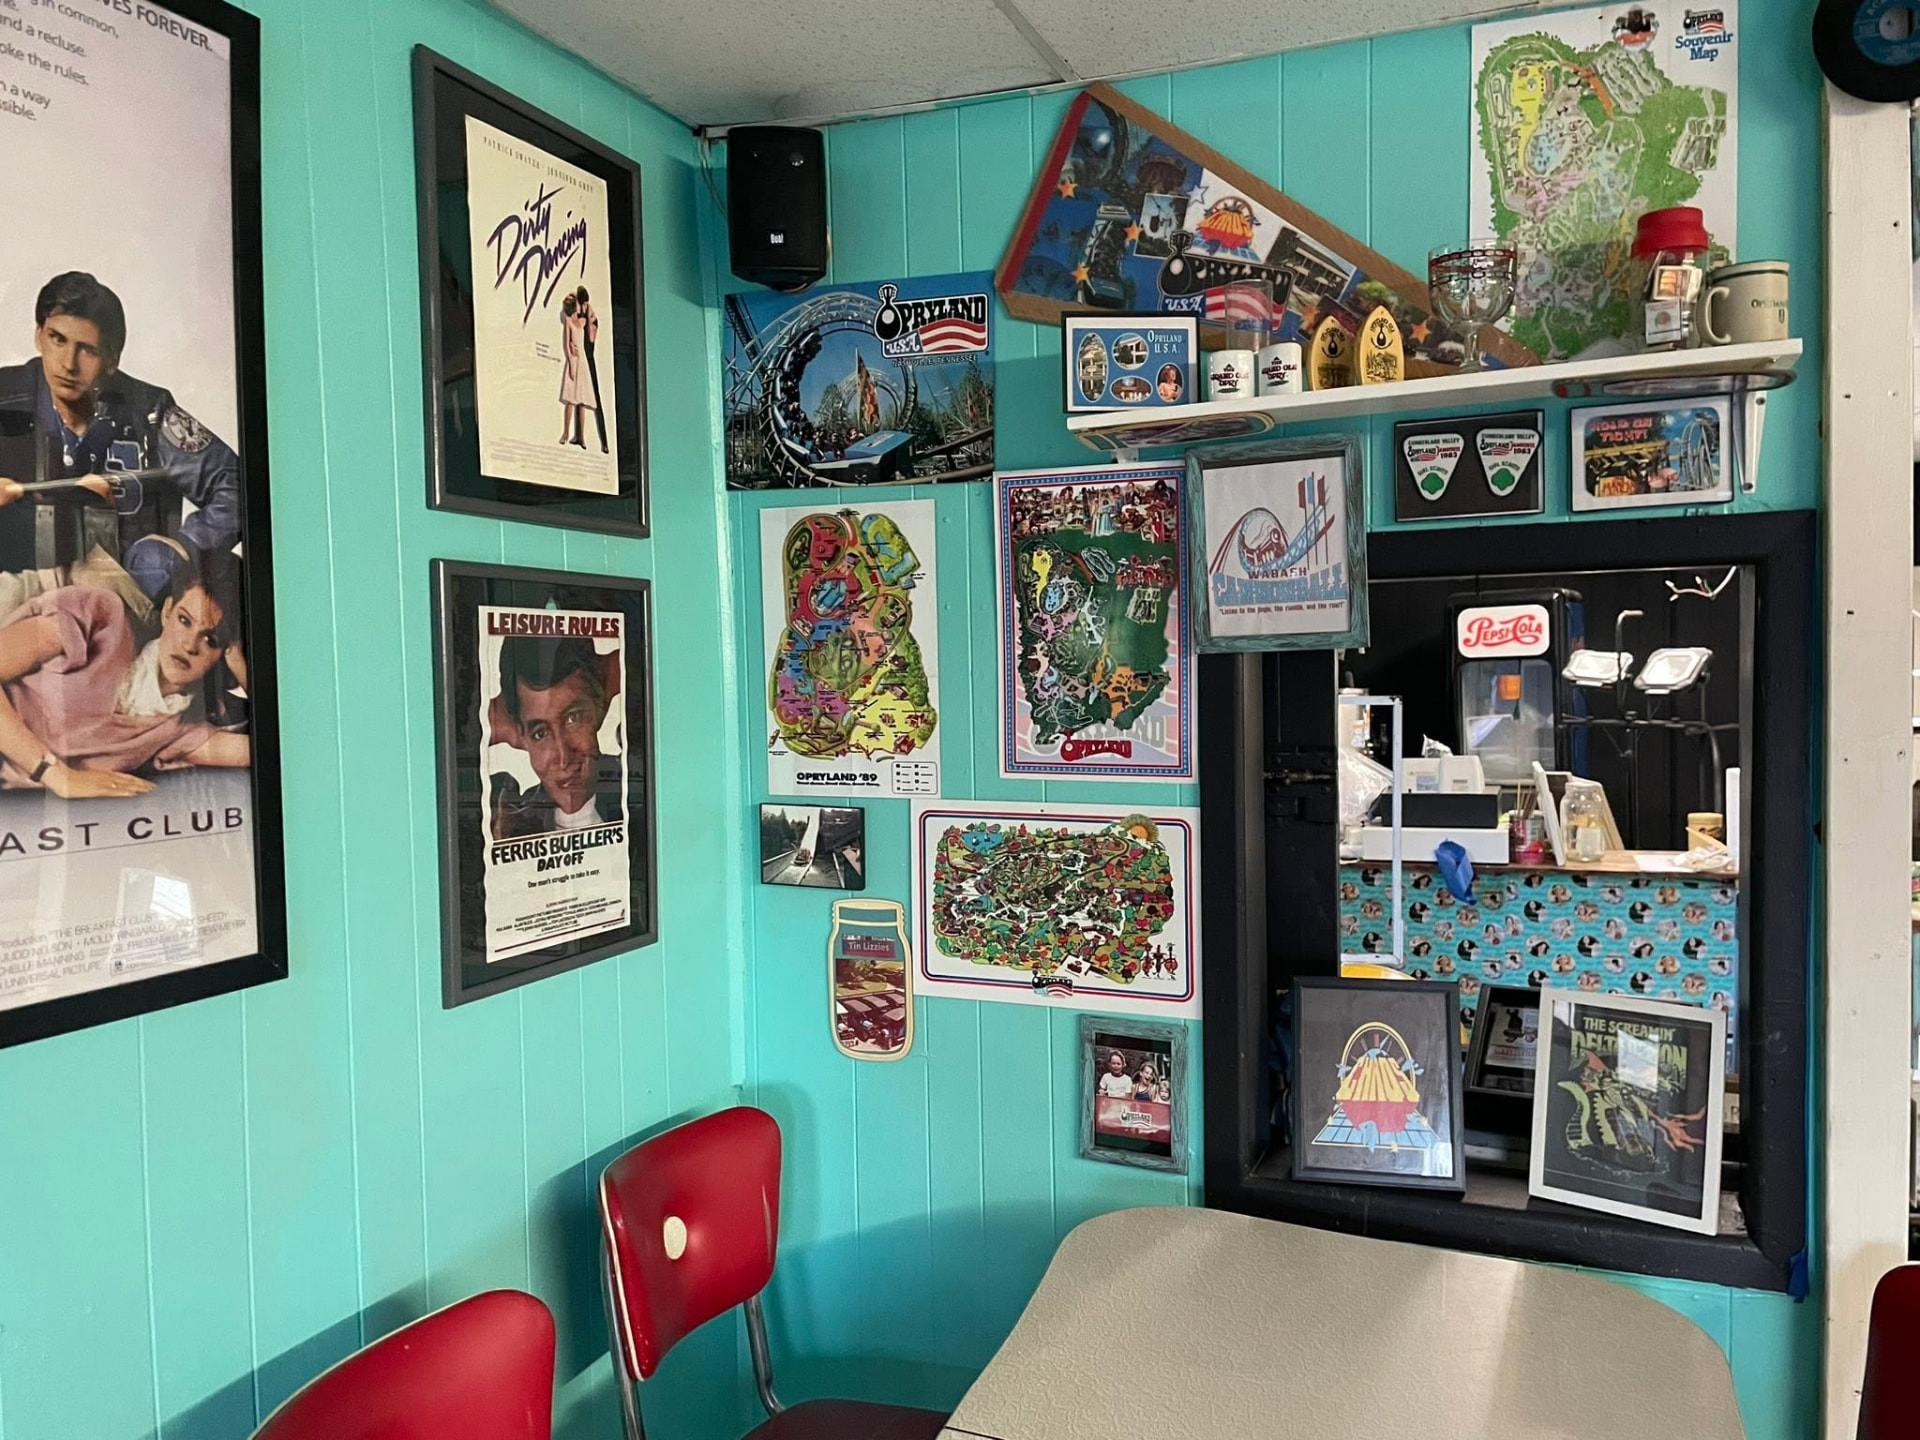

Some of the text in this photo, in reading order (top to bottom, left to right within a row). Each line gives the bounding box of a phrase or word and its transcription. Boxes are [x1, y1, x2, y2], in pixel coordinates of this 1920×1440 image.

[26, 25, 34, 36] a
[137, 5, 212, 52] FOREVER.
[1675, 31, 1733, 49] Souvenir
[28, 53, 51, 71] the
[1690, 46, 1719, 62] Map
[10, 85, 19, 96] a
[22, 88, 50, 109] way
[487, 183, 567, 291] Dirty
[513, 210, 587, 325] Dancing
[1148, 330, 1182, 343] OPRYLAND
[1248, 567, 1307, 580] WABASH
[488, 612, 620, 638] LEISURE RULES
[797, 772, 878, 781] OPRYLAND '89
[127, 807, 244, 840] CLUB
[491, 827, 624, 866] FERRIS BUELLER'S
[537, 851, 585, 872] DAY OFF
[848, 941, 890, 952] Tin Lizzies
[1583, 1016, 1607, 1032] THE
